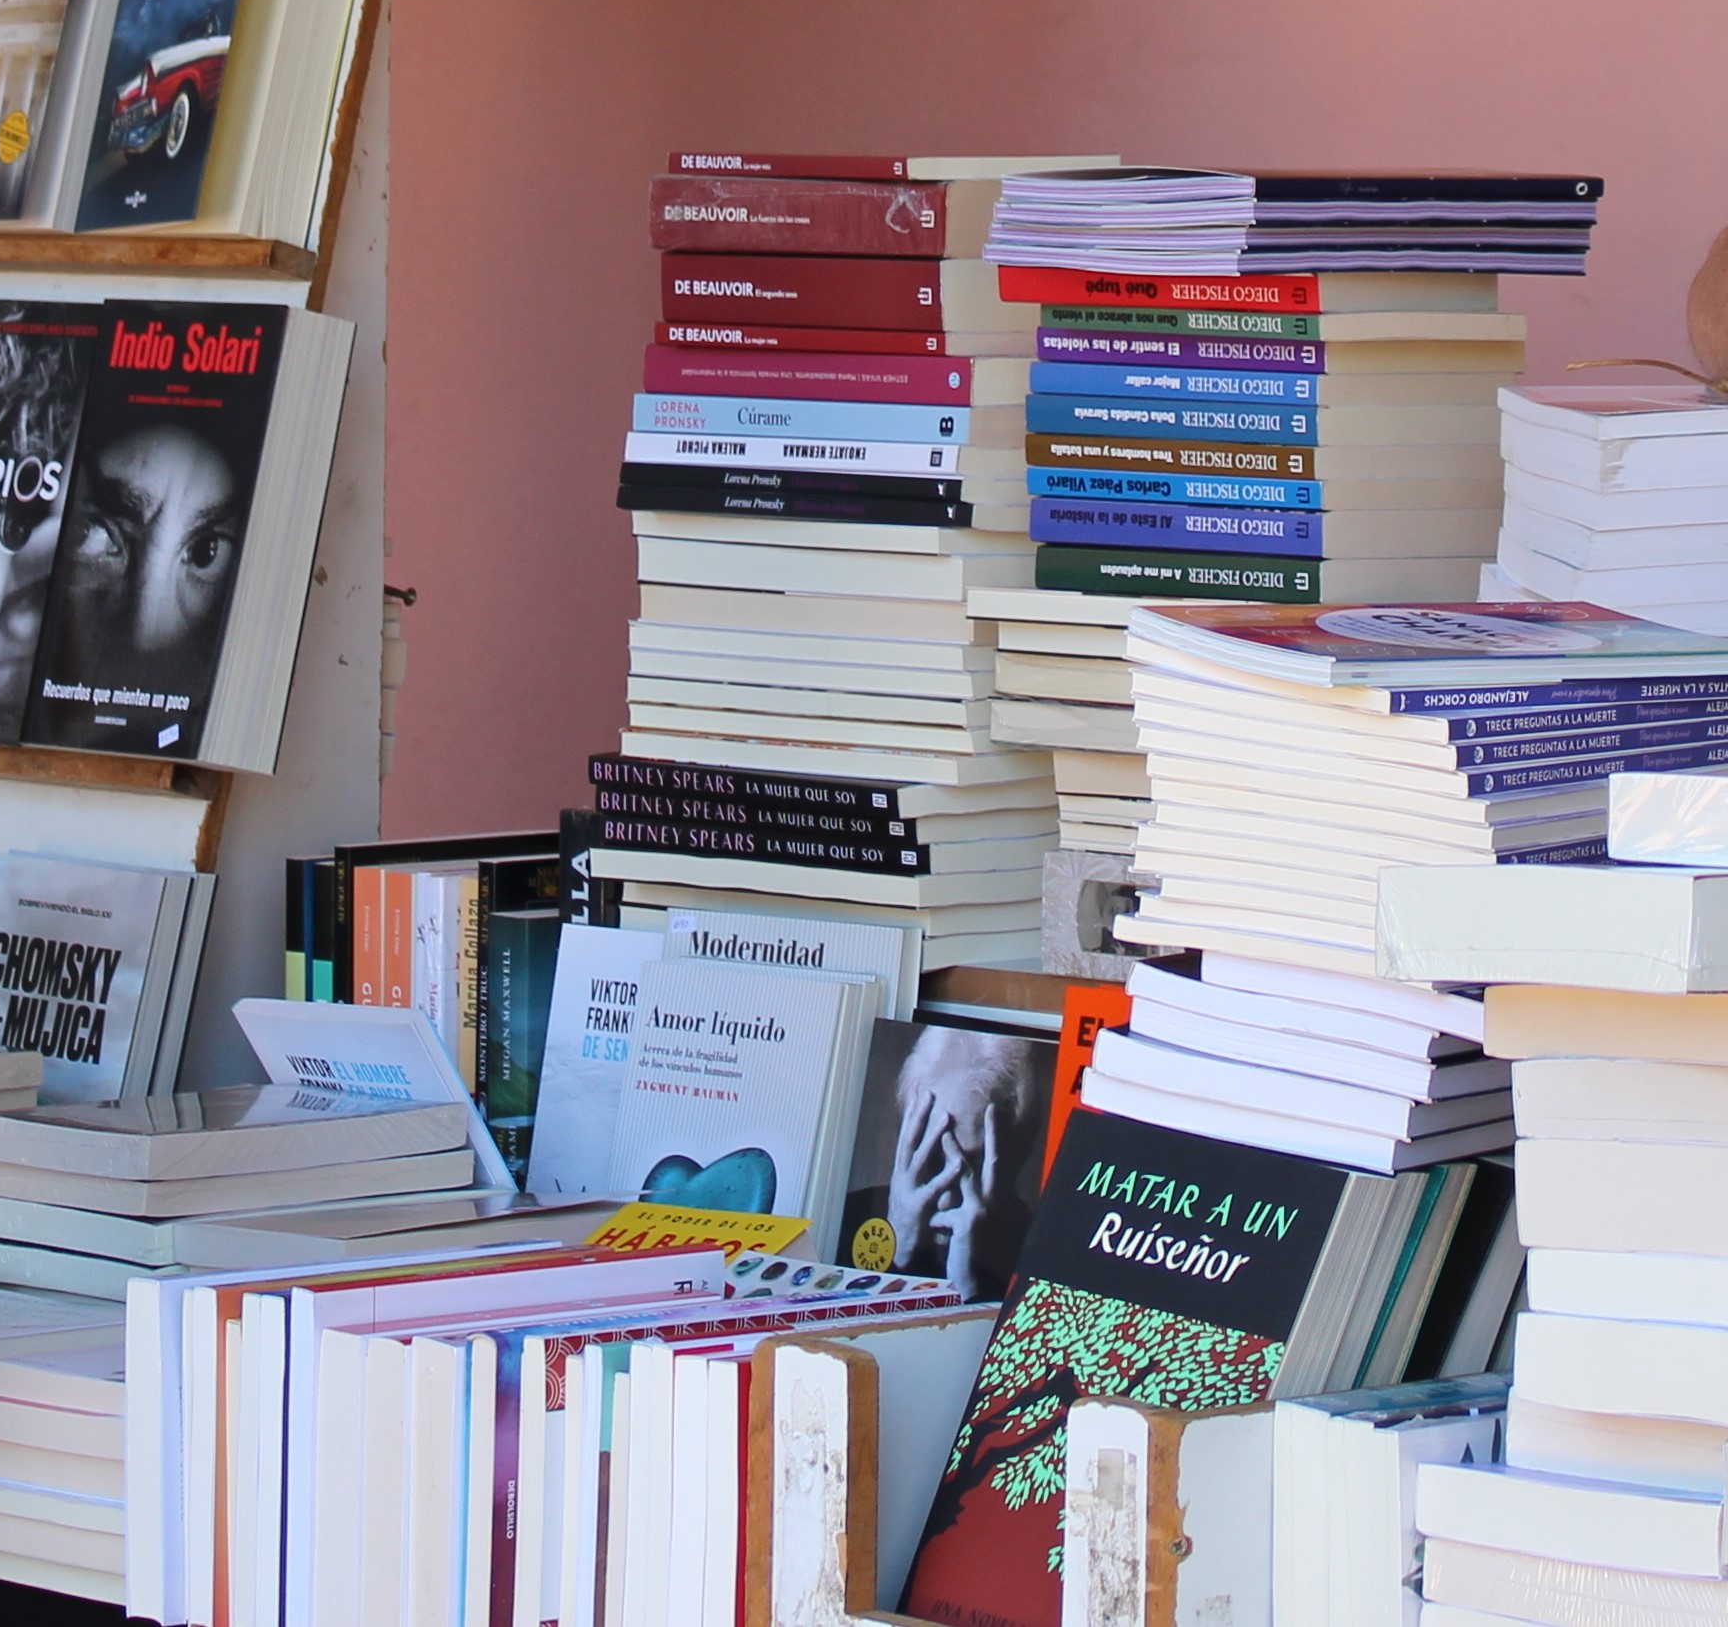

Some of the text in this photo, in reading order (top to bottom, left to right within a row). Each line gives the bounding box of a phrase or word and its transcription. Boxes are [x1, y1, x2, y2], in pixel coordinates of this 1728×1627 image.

[681, 155, 694, 169] DE
[695, 155, 742, 170] BEAUVOIR
[684, 206, 748, 222] BEAUVOIR
[675, 280, 754, 297] DE BEAUVOIR
[1172, 284, 1279, 303] DIEGO FISCHER
[110, 320, 263, 374] Indio Solari
[1043, 336, 1295, 361] DIEGO FISCHER sentir violetas
[655, 401, 700, 414] LORENA
[737, 407, 792, 426] Cúrame
[655, 416, 706, 429] PRONSKY
[712, 442, 746, 455] MALENA
[1127, 482, 1172, 496] Carlos
[43, 679, 190, 713] Recuerdos que mienten un poco
[1424, 690, 1530, 708] ALEJANDRO CORCHS
[1493, 734, 1620, 758] TRECE PREGUNTAS LA MUERTE
[593, 762, 857, 805] BRITNEY SPEARS LA MUJER QUE SOY
[605, 821, 755, 852] BRITNEY SPEARS
[687, 929, 825, 969] Modernidad
[590, 978, 638, 1007] VIKTOR
[503, 947, 512, 1081] MEGAN MAXWELL
[646, 1004, 785, 1045] Amor líquido
[2, 995, 106, 1065] MUJICA
[1077, 1161, 1299, 1241] MATAR A UN
[506, 1480, 515, 1539] DEBOLSILLO
